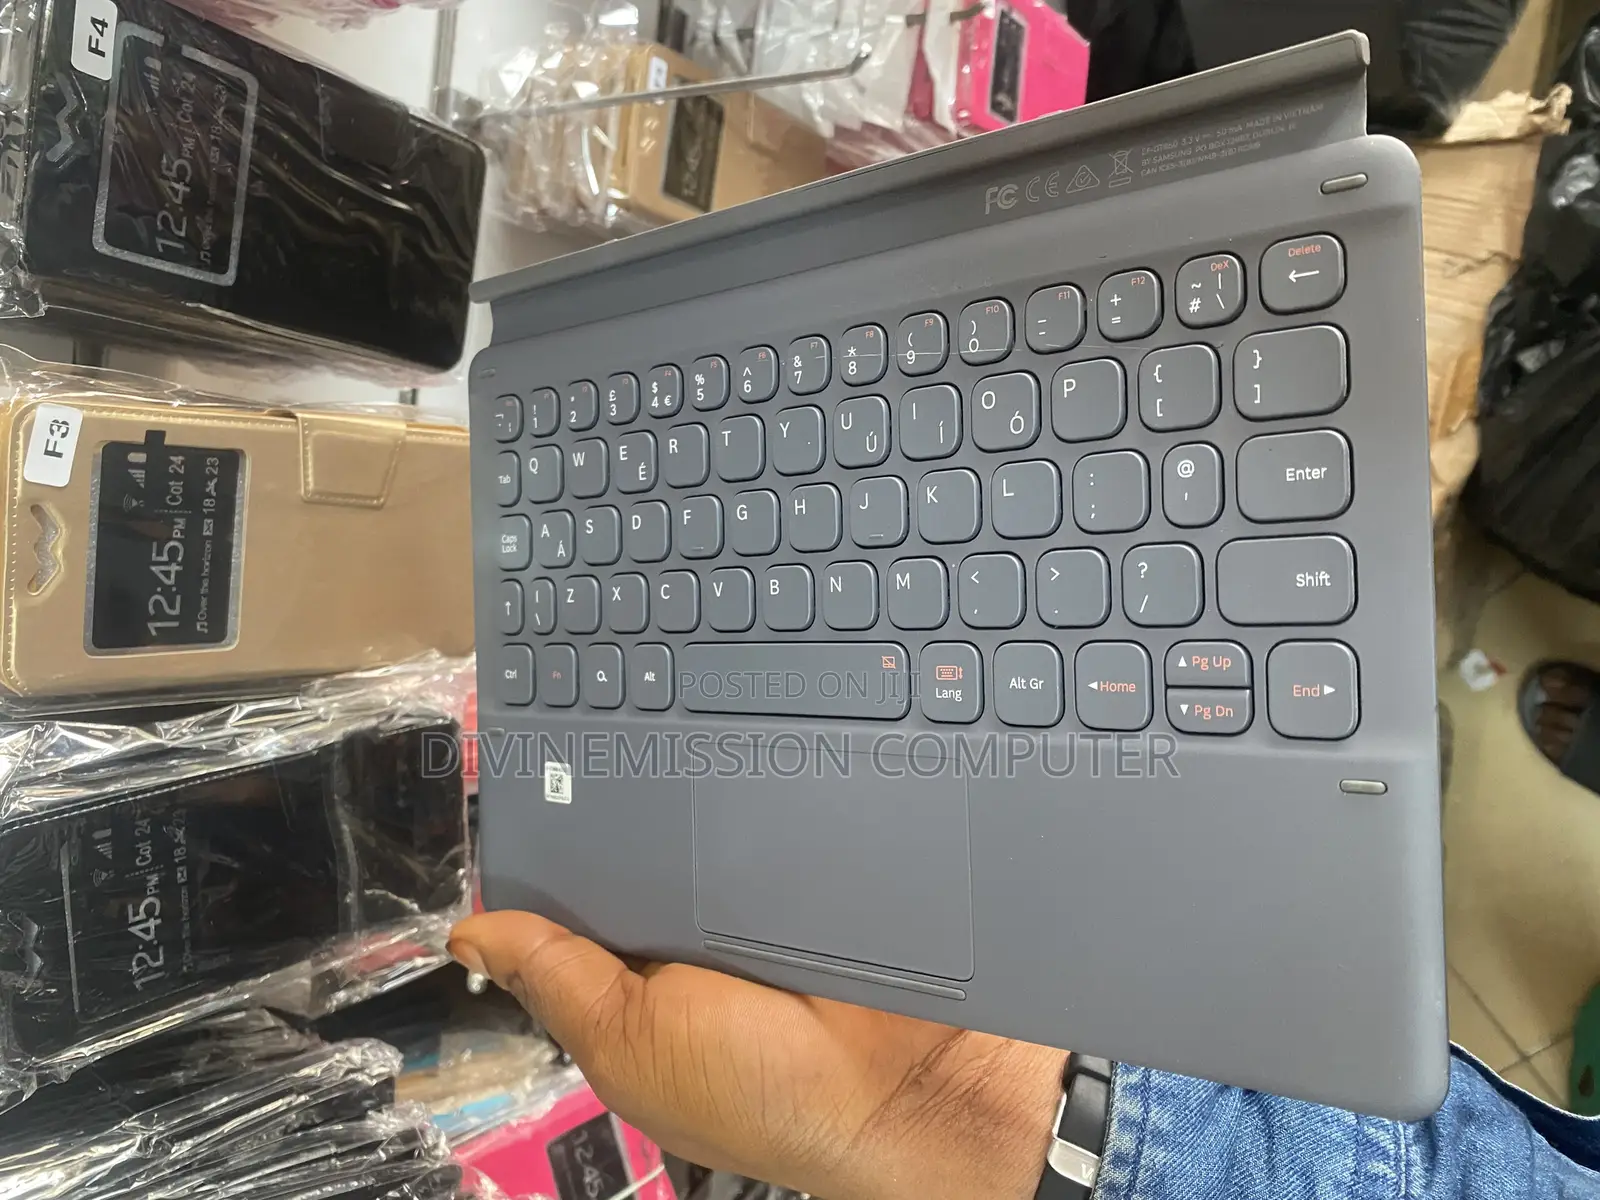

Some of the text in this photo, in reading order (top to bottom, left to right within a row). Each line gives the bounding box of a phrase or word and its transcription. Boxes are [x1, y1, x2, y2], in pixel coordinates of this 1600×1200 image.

[88, 16, 109, 58] F4
[1152, 147, 1192, 164] SAMSUNG
[155, 155, 193, 254] 12:45
[186, 137, 197, 159] PM
[1287, 243, 1321, 258] Delete
[1210, 259, 1230, 272] DeX
[1131, 275, 1146, 287] F12
[1057, 290, 1071, 301] F11
[1110, 293, 1122, 307] +
[985, 304, 1000, 315] F10
[1188, 297, 1202, 313] #
[924, 318, 934, 328] F9
[865, 330, 874, 340] F8
[793, 355, 803, 368] &
[906, 350, 916, 365] 9
[1252, 349, 1263, 369] }
[848, 361, 857, 376] 8
[1153, 364, 1163, 383] {
[694, 373, 705, 386] %
[794, 371, 803, 384] 7
[651, 381, 659, 394] $
[696, 388, 705, 401] 5
[743, 380, 752, 393] 6
[1062, 379, 1076, 398] P
[1253, 384, 1261, 404] ]
[608, 389, 617, 402] £
[651, 394, 672, 408] 4 €
[980, 390, 996, 410] O
[609, 403, 617, 416] 3
[1156, 398, 1163, 417] [
[569, 410, 577, 423] 2
[840, 412, 853, 430] U
[1009, 411, 1025, 435] Ó
[779, 421, 790, 438] Y
[43, 418, 70, 459] F3
[668, 438, 678, 454] R
[721, 430, 731, 447] T
[866, 431, 878, 452] Ú
[572, 451, 585, 467] W
[619, 445, 628, 461] E
[205, 457, 219, 477] 23
[529, 457, 539, 475] Q
[638, 462, 647, 481] É
[1176, 459, 1195, 478] @
[1285, 465, 1328, 483] Enter
[498, 475, 511, 485] Tab
[1002, 478, 1015, 498] L
[859, 492, 869, 510] J
[926, 486, 939, 504] K
[202, 498, 216, 514] 18
[736, 504, 748, 521] G
[794, 498, 806, 516] H
[631, 514, 642, 530] D
[683, 509, 692, 525] F
[540, 523, 550, 539] A
[585, 519, 594, 535] S
[147, 455, 186, 637] 12:45 PM Cot 24
[501, 533, 518, 545] Caps
[501, 544, 518, 554] Lock
[556, 540, 566, 558] Á
[201, 539, 213, 578] horizon
[970, 570, 980, 584] <
[1049, 567, 1061, 582] >
[1137, 561, 1149, 580] ?
[769, 579, 780, 596] B
[829, 576, 843, 593] N
[895, 572, 911, 590] M
[1295, 571, 1331, 588] Shift
[566, 588, 575, 604] Z
[612, 586, 621, 602] X
[660, 583, 671, 600] C
[712, 581, 724, 598] V
[197, 599, 208, 621] Over
[1139, 594, 1150, 613] /
[1191, 655, 1232, 671] Pg Up
[504, 668, 518, 679] Ctrl
[552, 670, 562, 680] Fn
[643, 671, 656, 683] Alt
[1009, 677, 1044, 691] Alt Gr
[1099, 680, 1137, 694] Home
[1292, 684, 1320, 698] End
[935, 687, 963, 702] Lang
[1194, 704, 1234, 720] Pg Dn
[135, 817, 152, 837] 24
[174, 846, 187, 864] 18
[146, 872, 161, 896] PM
[128, 896, 166, 991] 12:45
